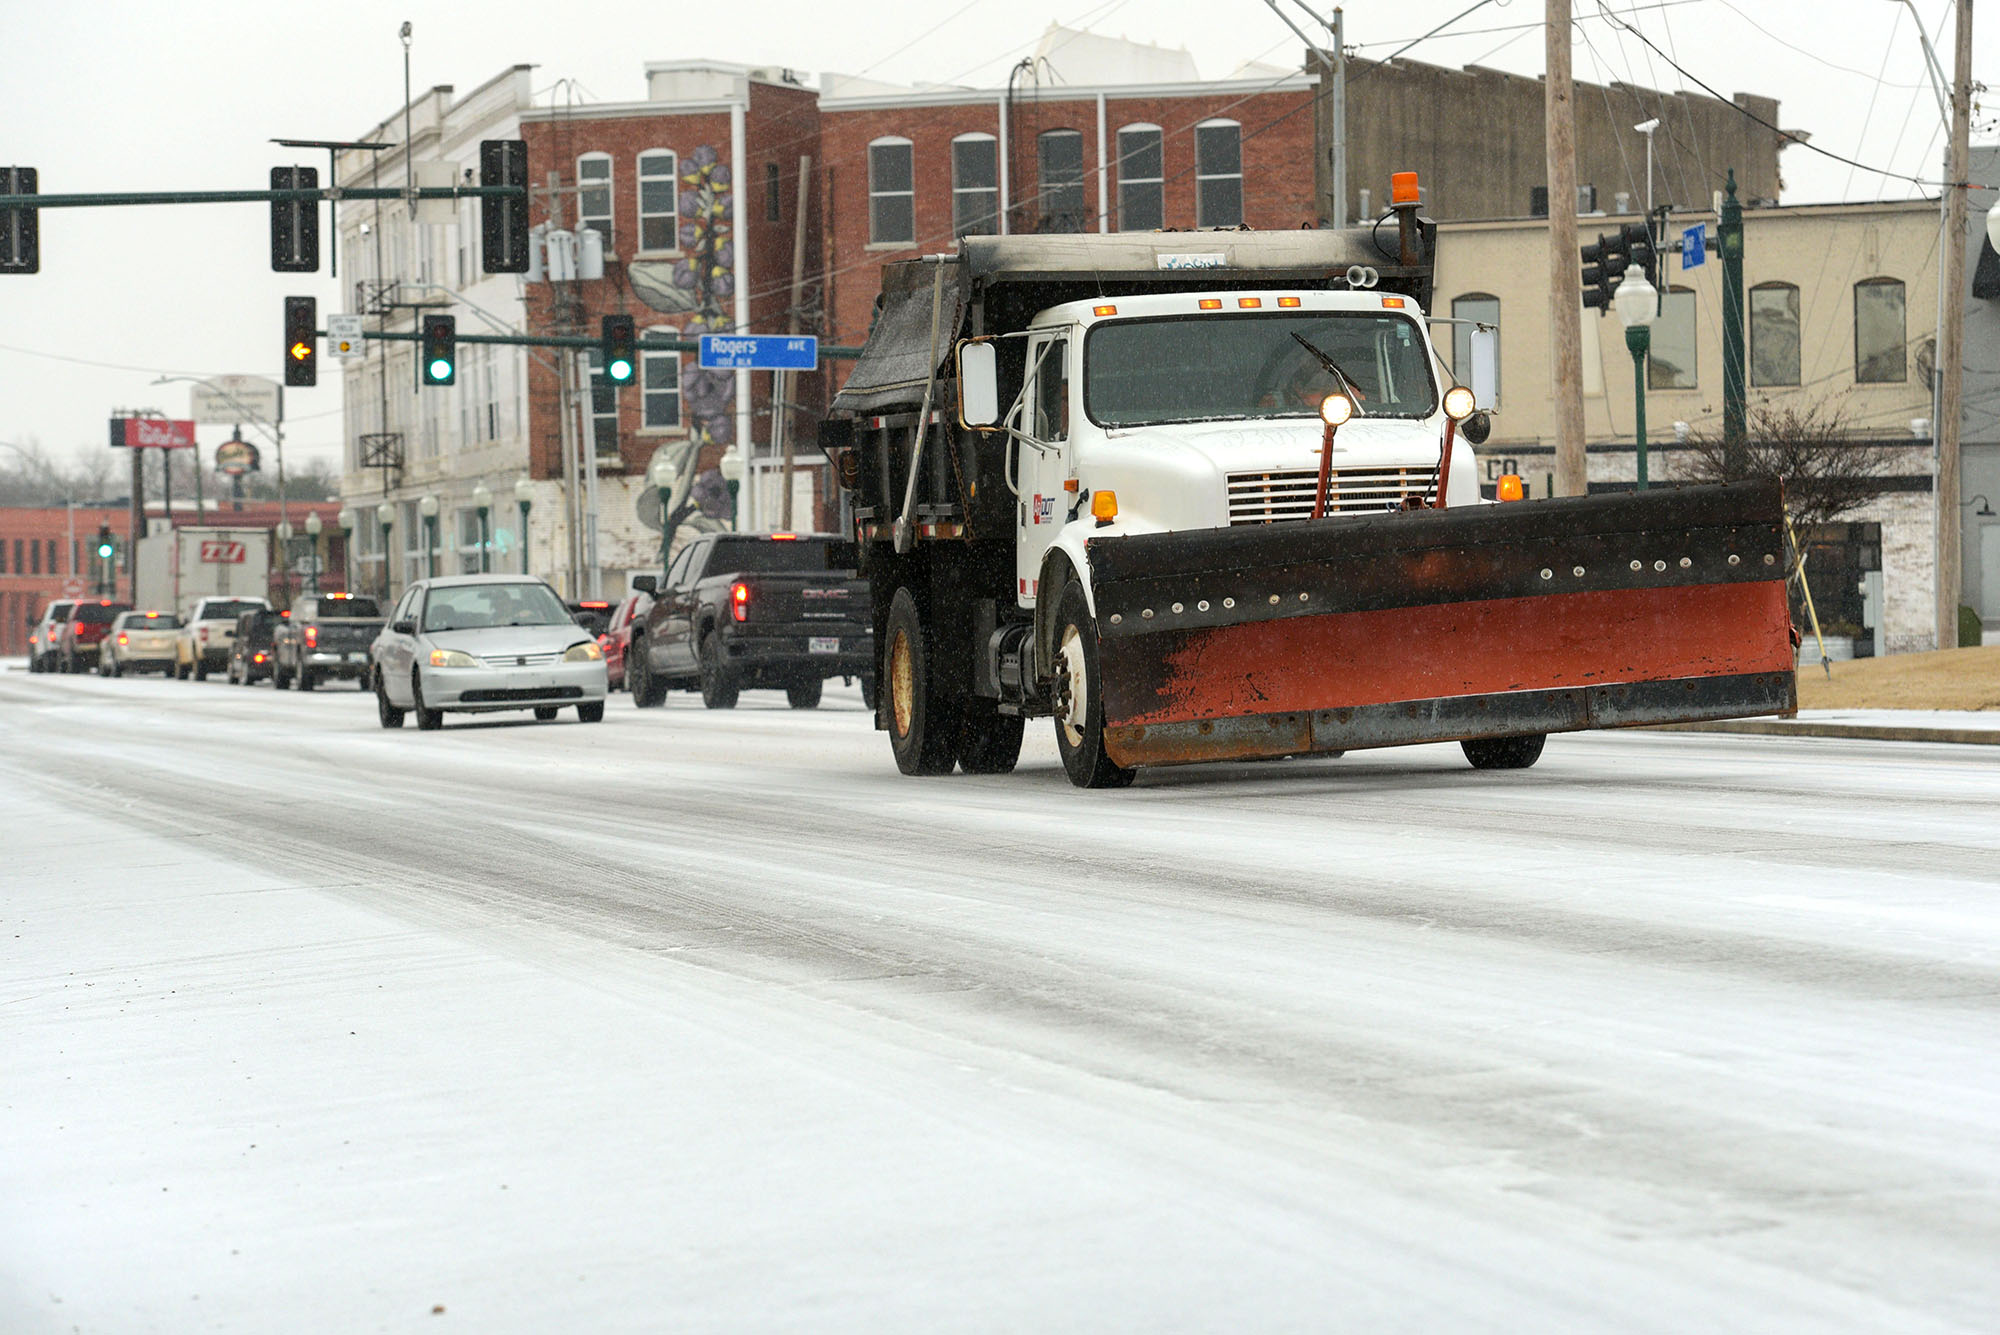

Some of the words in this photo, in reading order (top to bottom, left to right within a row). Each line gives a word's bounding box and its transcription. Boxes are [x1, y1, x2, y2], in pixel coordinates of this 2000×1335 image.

[711, 338, 757, 358] Rogers
[787, 340, 806, 351] AVE
[803, 589, 849, 599] GMC
